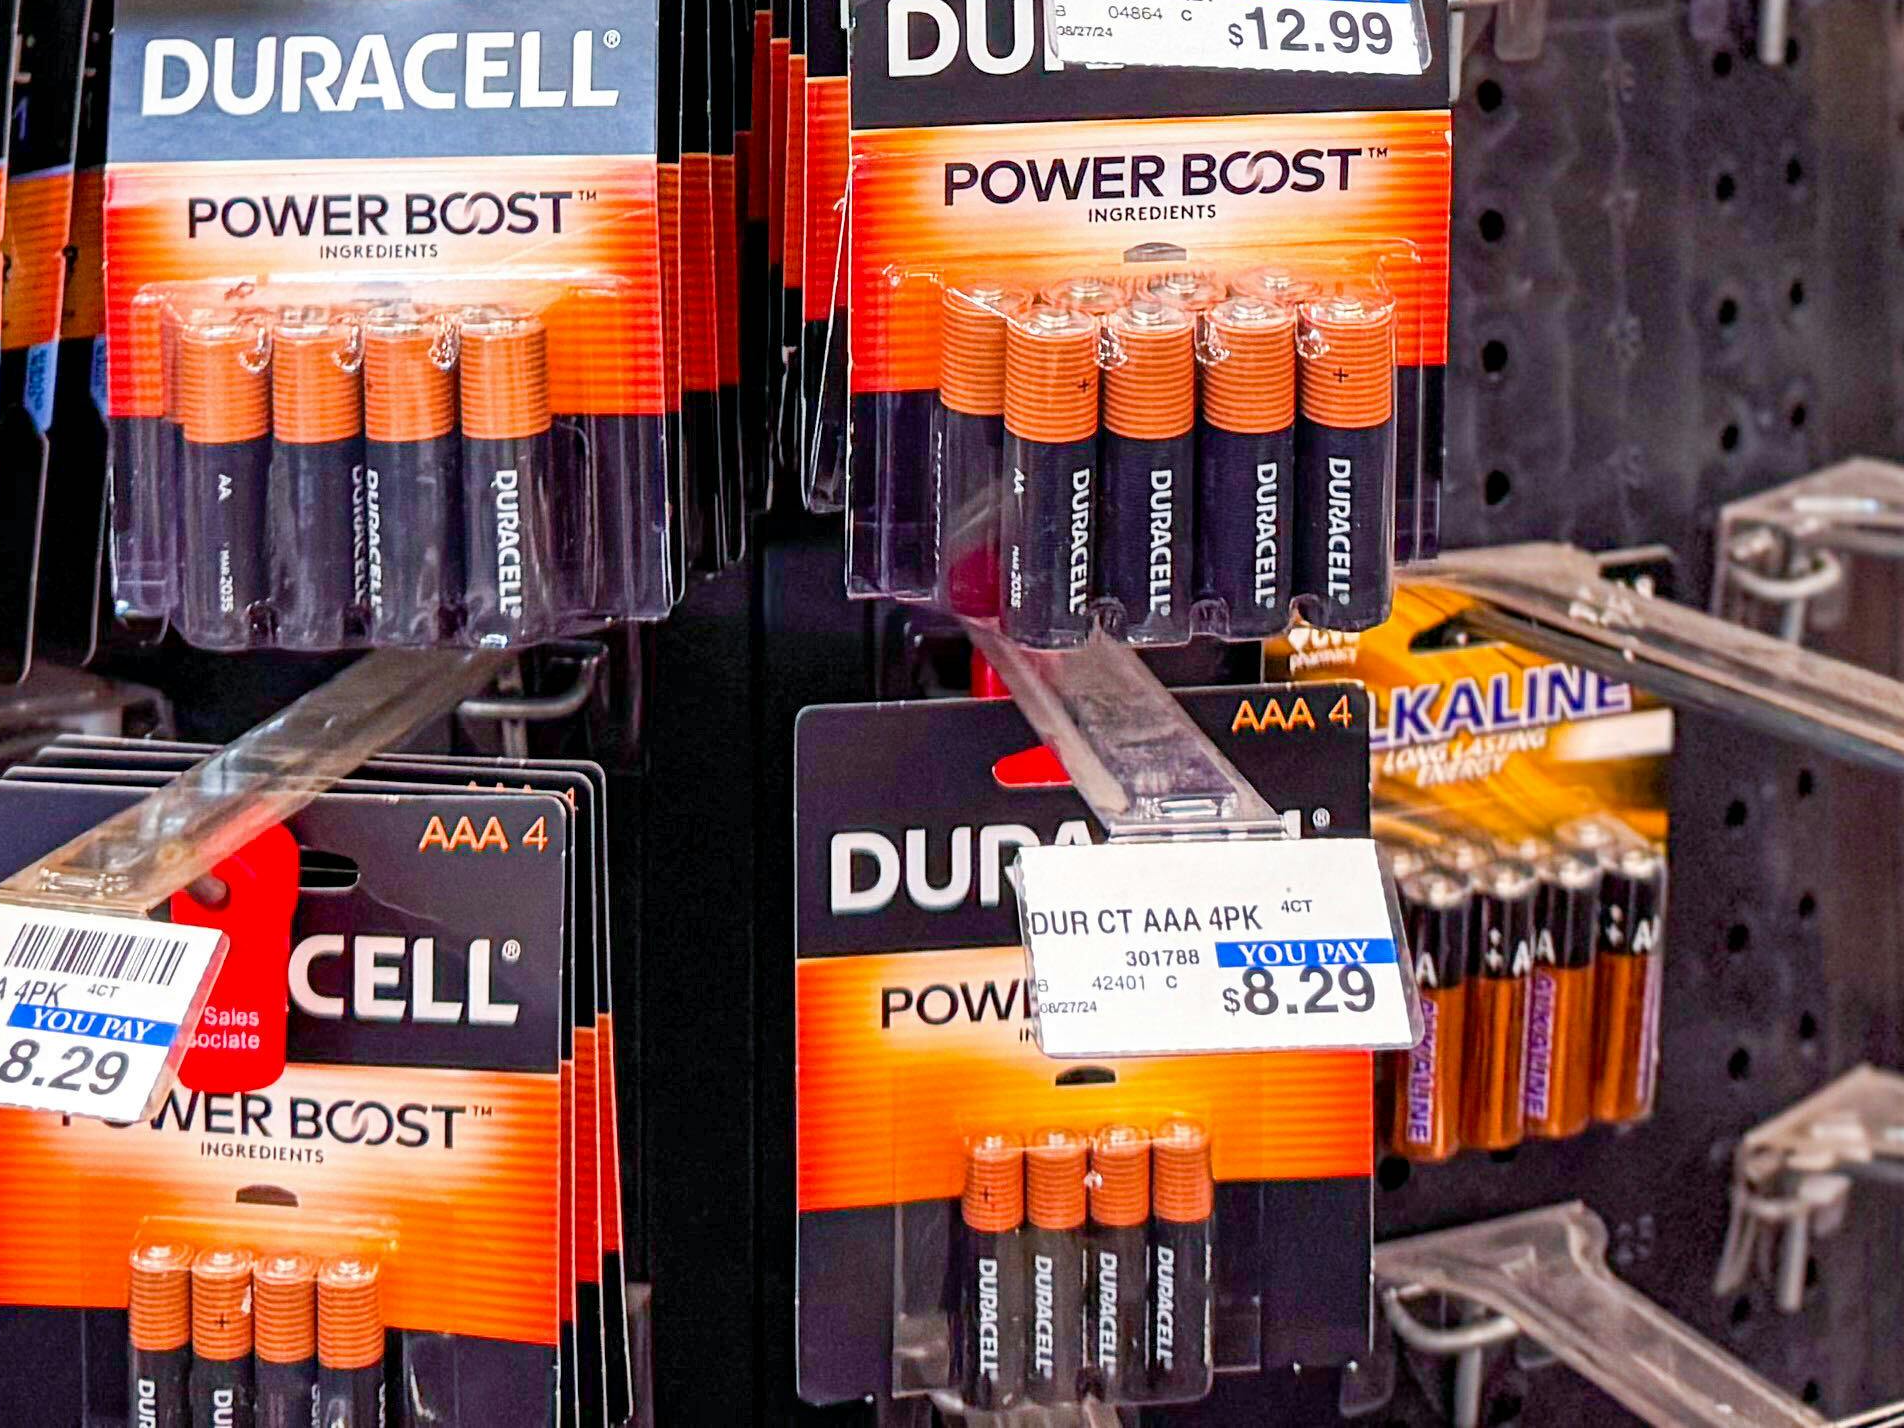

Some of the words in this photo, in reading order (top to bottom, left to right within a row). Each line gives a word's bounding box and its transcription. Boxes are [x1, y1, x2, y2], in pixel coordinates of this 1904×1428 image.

[1229, 6, 1392, 54] $12.99
[142, 30, 619, 117] DURACELL
[945, 156, 1166, 207] POWER
[1182, 147, 1361, 197] BOOST
[189, 195, 389, 239] POWER
[406, 191, 572, 236] BOOST
[1087, 205, 1216, 223] INGREDIENTS
[320, 244, 438, 260] INGREDIENTS
[1149, 469, 1173, 611] DURACELL
[1254, 462, 1278, 604] DURACELL
[1327, 457, 1351, 598] DURACELL
[1232, 700, 1315, 734] AAA
[1329, 696, 1352, 729] 4
[419, 817, 509, 852] AAA
[522, 817, 547, 850] 4
[1031, 910, 1088, 936] DUR
[1098, 909, 1132, 934] CT
[1145, 907, 1201, 933] AAA
[1209, 905, 1263, 932] 4PK
[1126, 949, 1200, 967] 301788
[1238, 943, 1306, 965] YOU
[1316, 942, 1369, 962] PAY
[14, 980, 68, 1006] 4PK
[1092, 976, 1146, 991] 42401
[1223, 966, 1376, 1016] $8.29
[205, 1008, 260, 1027] Sales
[290, 1101, 471, 1149] BOOST
[200, 1141, 324, 1164] INGREDIENTS
